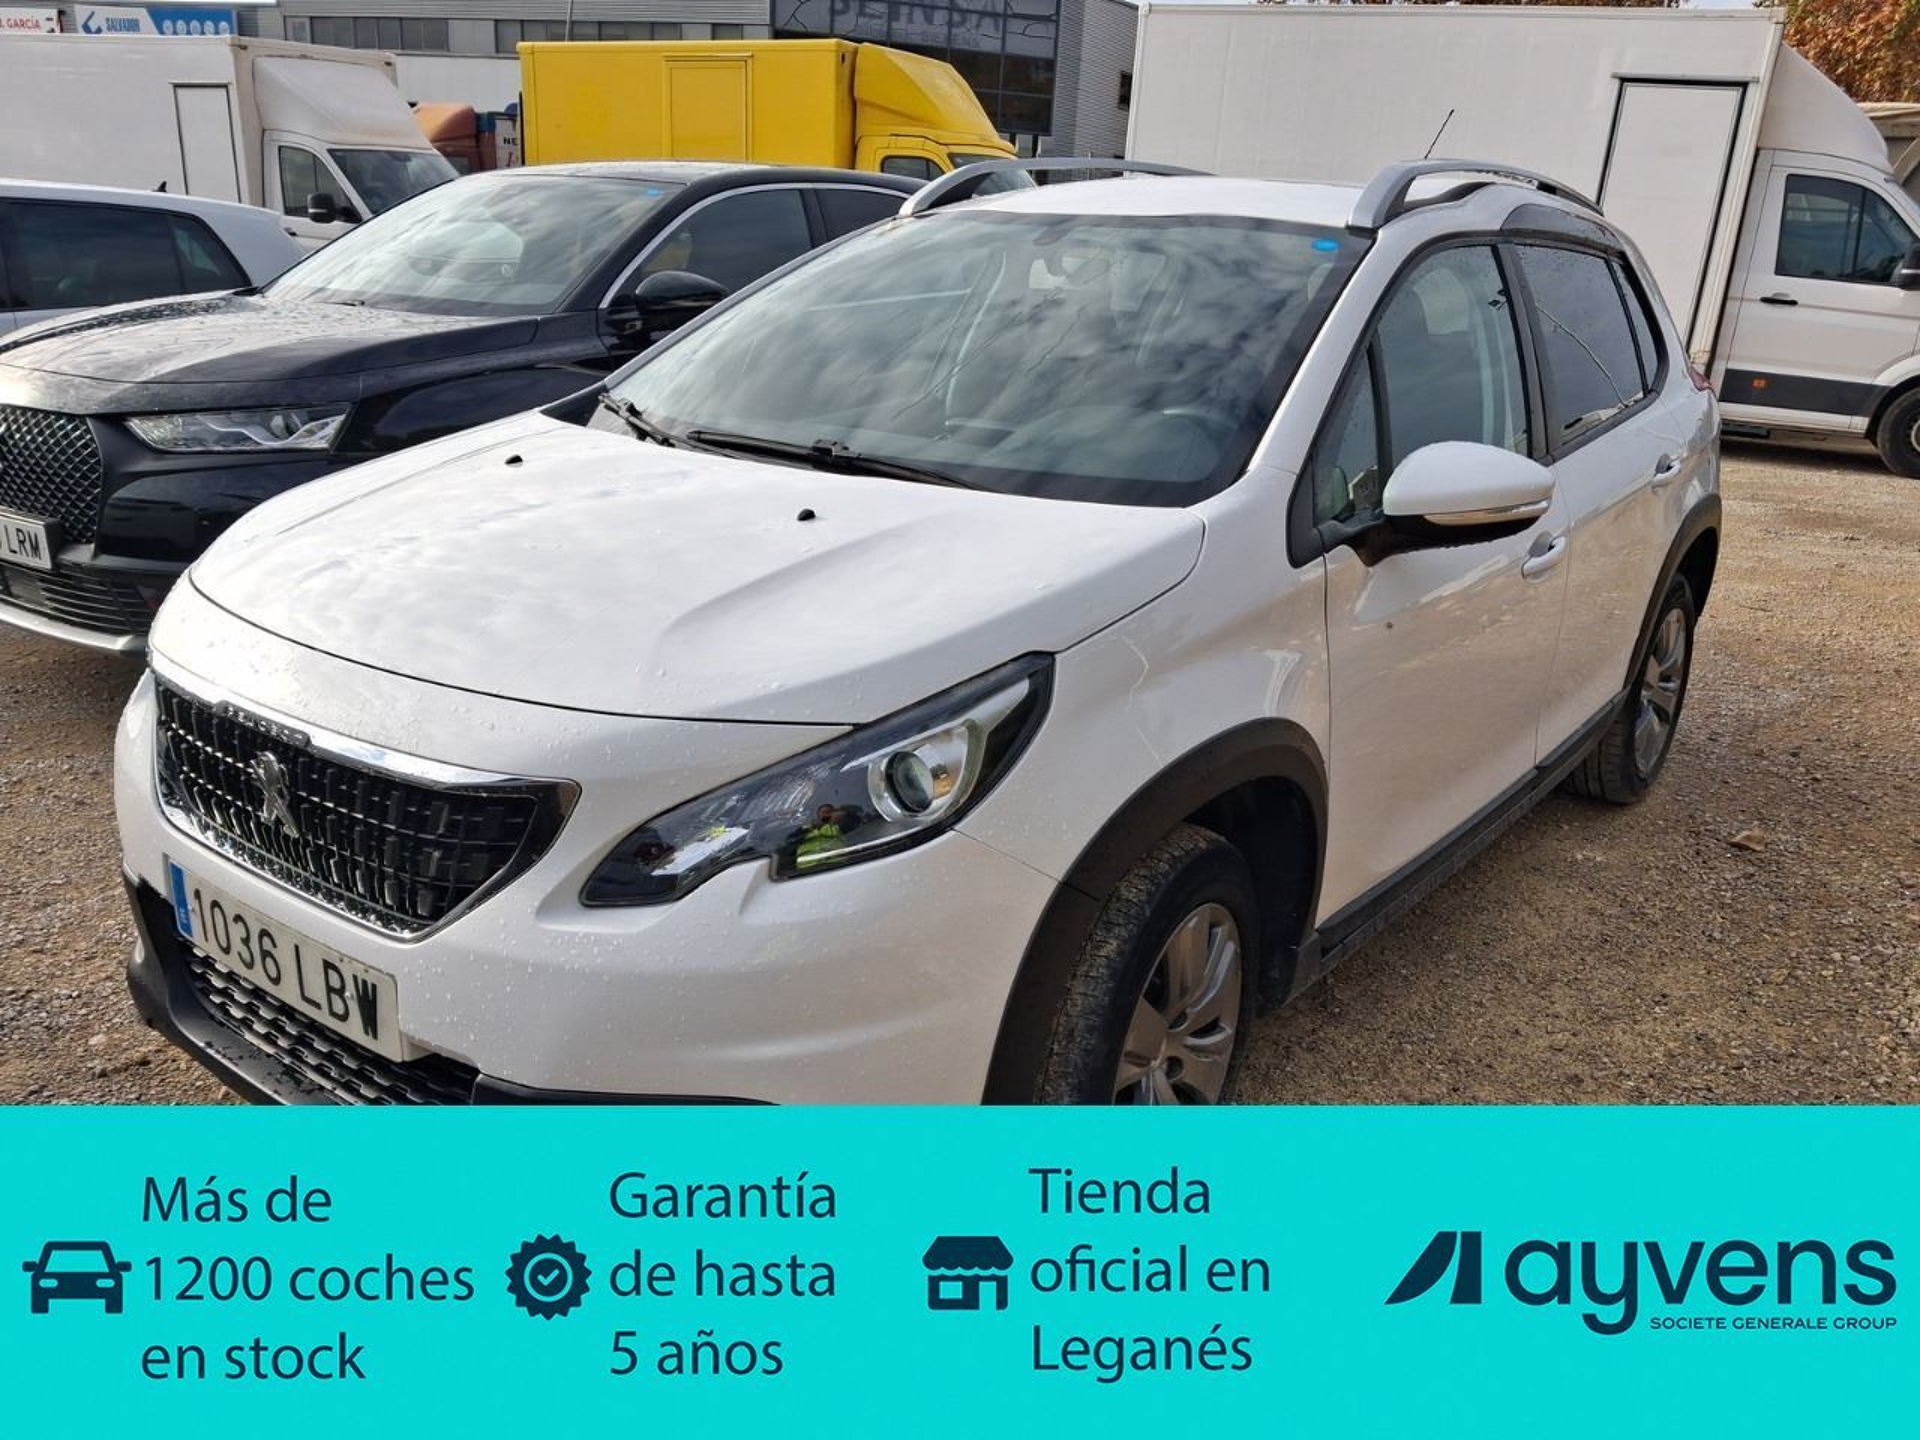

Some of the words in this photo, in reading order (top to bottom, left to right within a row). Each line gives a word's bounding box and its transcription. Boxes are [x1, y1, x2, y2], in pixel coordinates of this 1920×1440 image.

[105, 17, 140, 32] SALVADOR
[4, 525, 42, 560] LRM
[194, 887, 282, 987] 1036
[294, 943, 378, 1041] LBW
